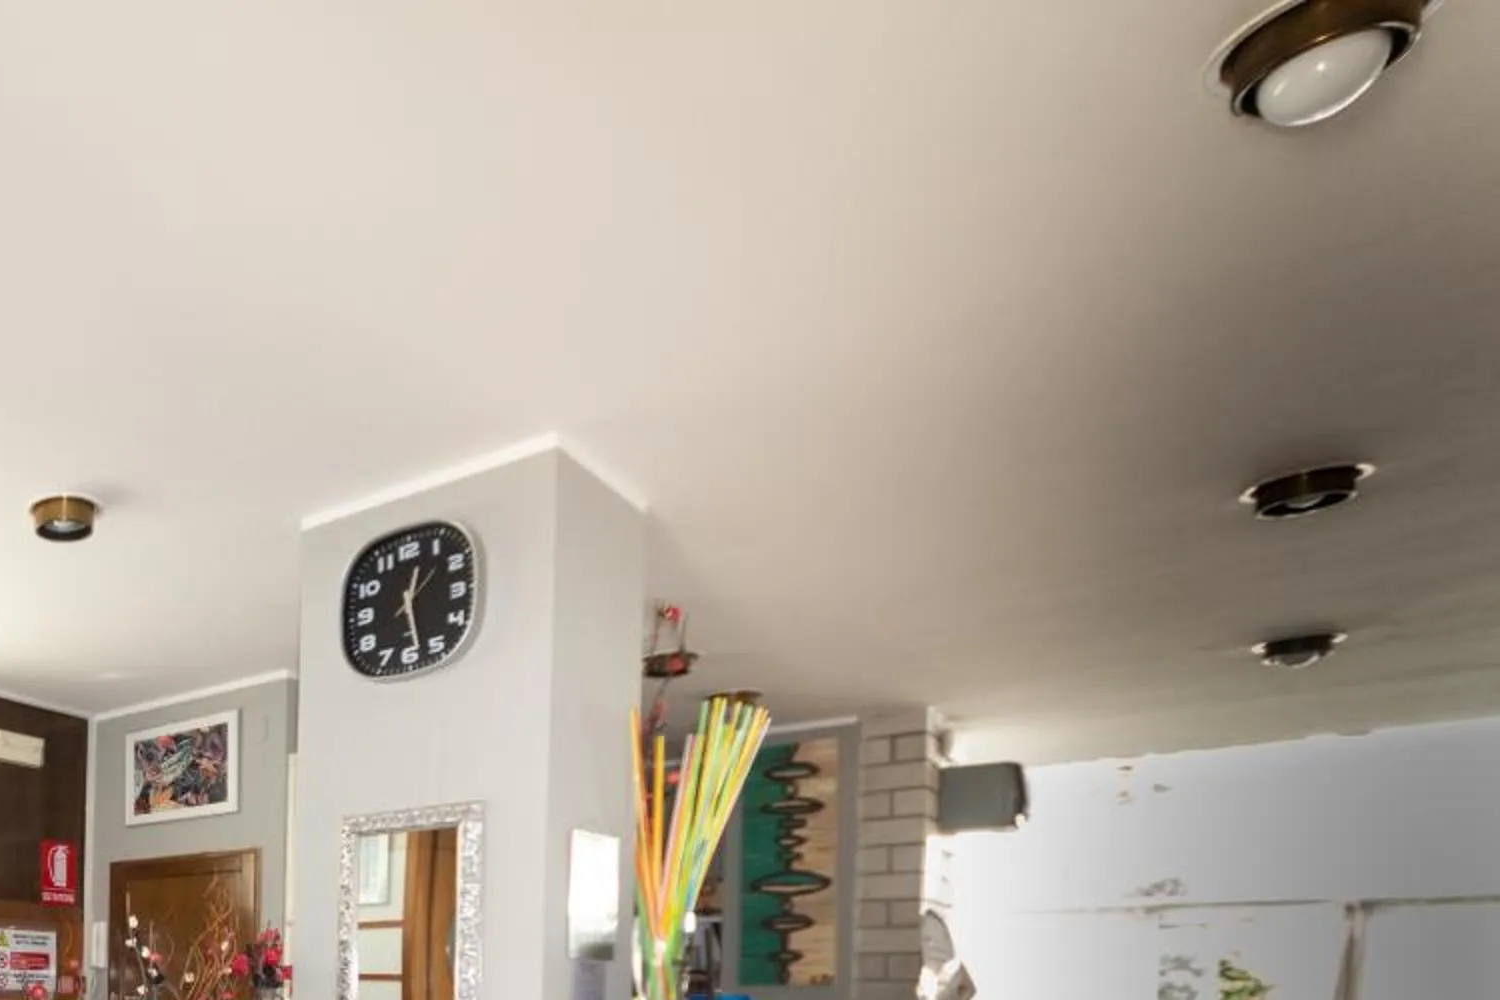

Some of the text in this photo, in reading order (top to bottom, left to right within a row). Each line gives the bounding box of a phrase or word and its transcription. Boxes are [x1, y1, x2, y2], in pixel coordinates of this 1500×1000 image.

[399, 541, 420, 561] 12
[432, 538, 440, 556] 1
[377, 554, 394, 574] 11
[448, 553, 465, 571] 2
[358, 580, 381, 599] 10
[450, 581, 467, 599] 3
[357, 608, 375, 626] 9
[448, 609, 465, 626] 4
[359, 634, 377, 652] 8
[428, 635, 445, 654] 5
[379, 648, 394, 667] 7
[401, 646, 419, 664] 6
